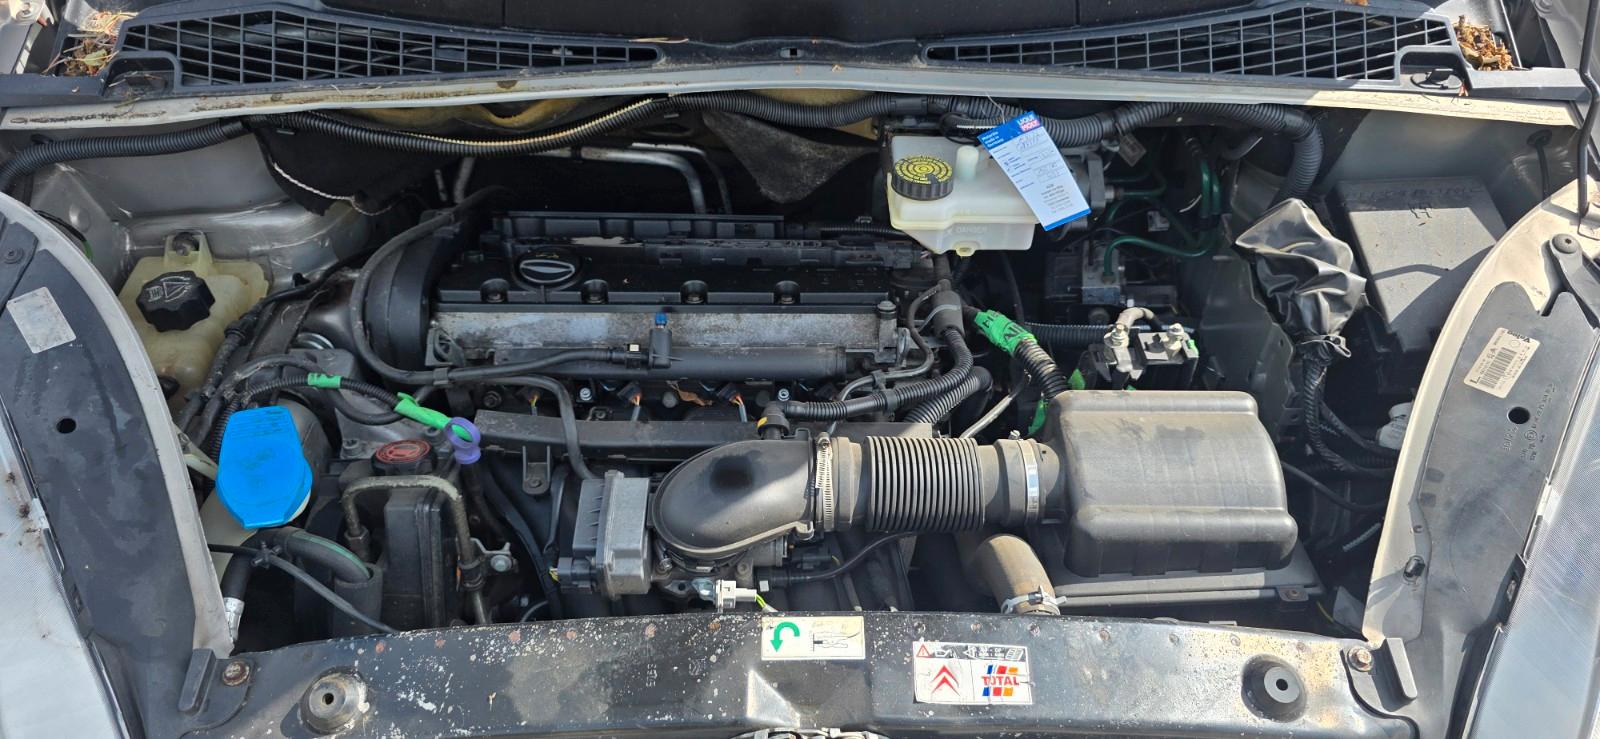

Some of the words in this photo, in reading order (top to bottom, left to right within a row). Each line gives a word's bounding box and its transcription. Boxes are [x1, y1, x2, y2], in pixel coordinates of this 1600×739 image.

[1021, 120, 1040, 132] MOLY
[1507, 331, 1530, 343] Valeo
[981, 676, 1020, 686] TOTAL
